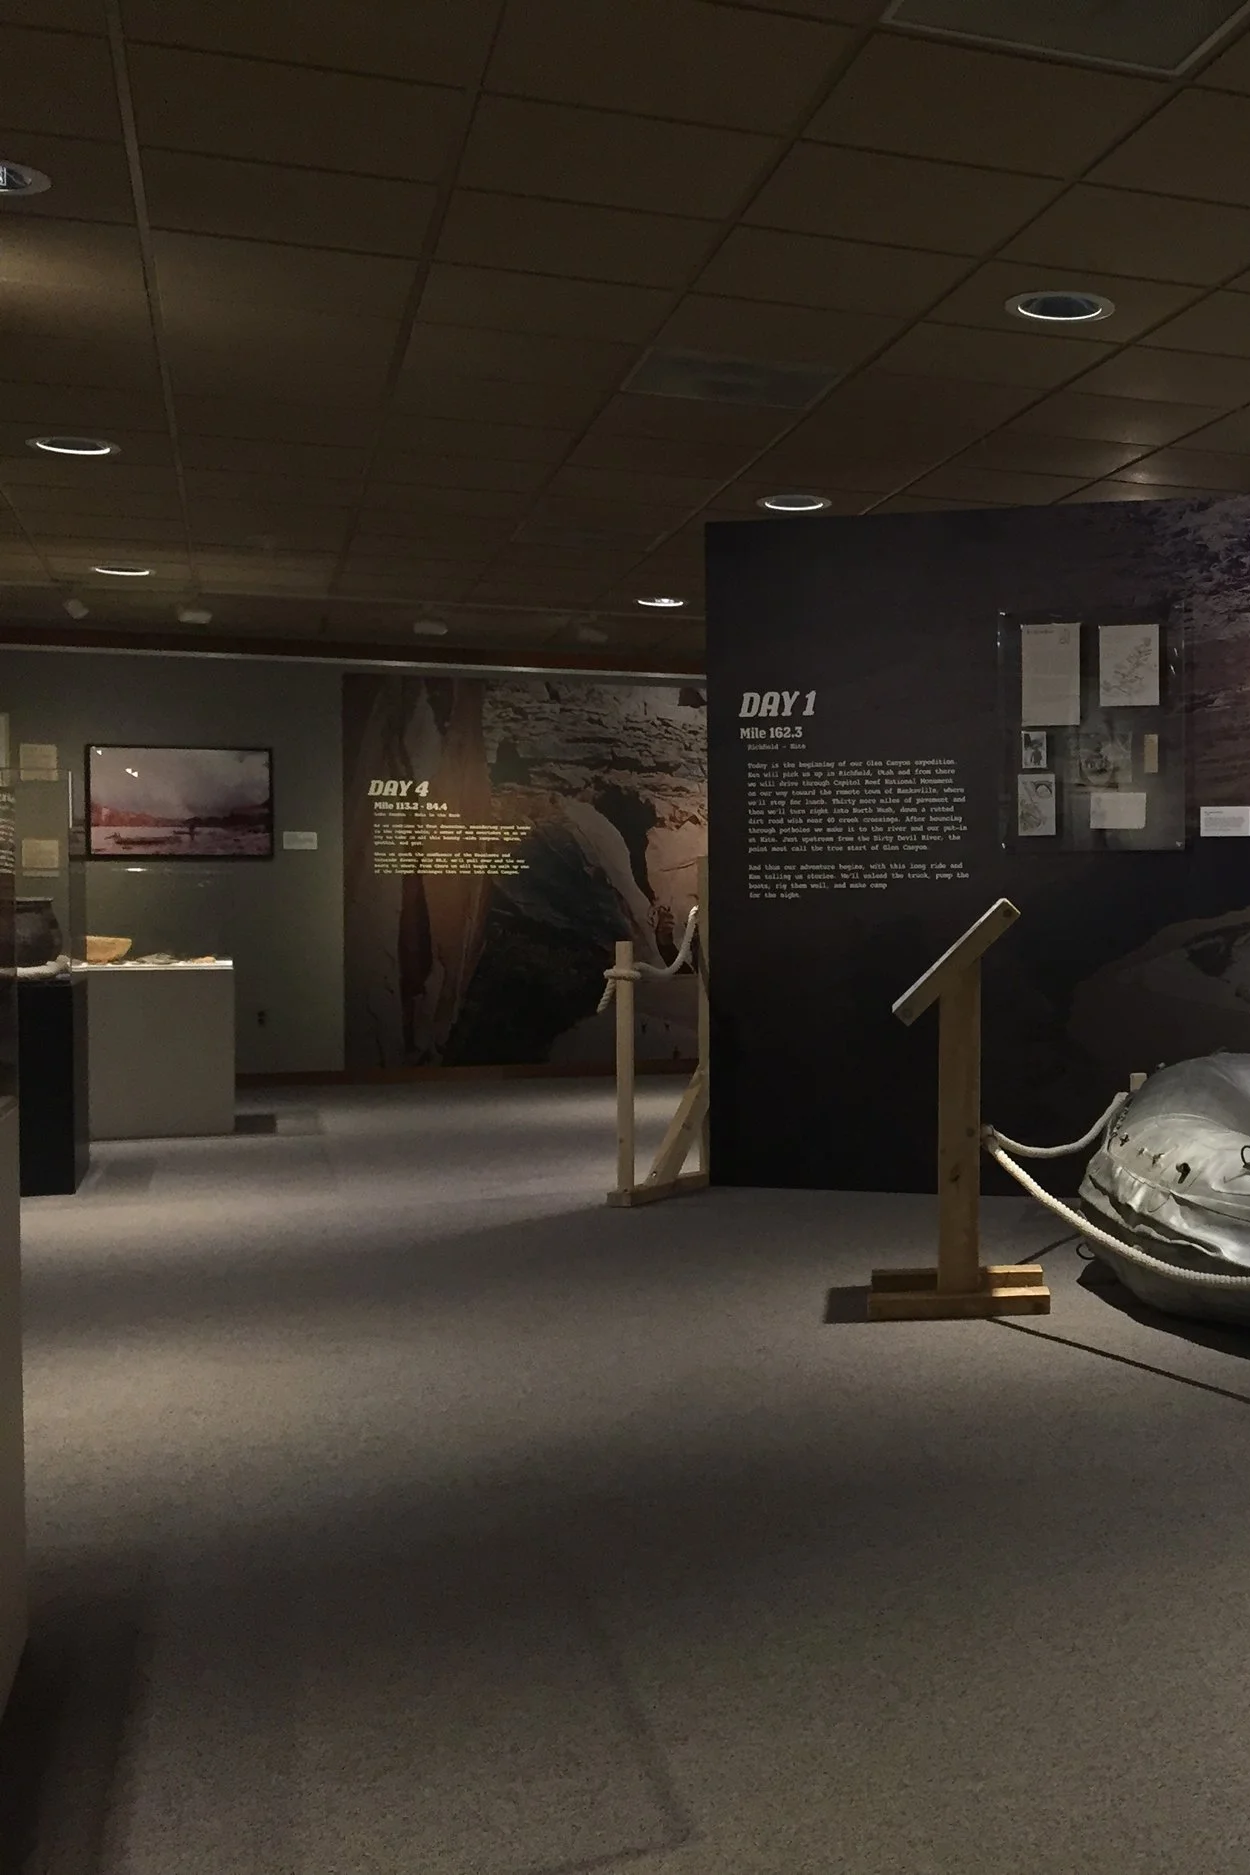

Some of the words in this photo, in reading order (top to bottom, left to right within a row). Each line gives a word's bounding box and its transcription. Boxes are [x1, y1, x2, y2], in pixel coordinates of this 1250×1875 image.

[738, 691, 800, 717] DAY
[802, 690, 816, 716] 1
[740, 727, 766, 739] Mile
[769, 726, 803, 738] 162.3
[368, 780, 413, 796] DAY
[415, 781, 429, 797] 4
[374, 802, 394, 810] Mile
[396, 802, 419, 810] 113.2
[426, 802, 448, 811] 84.4
